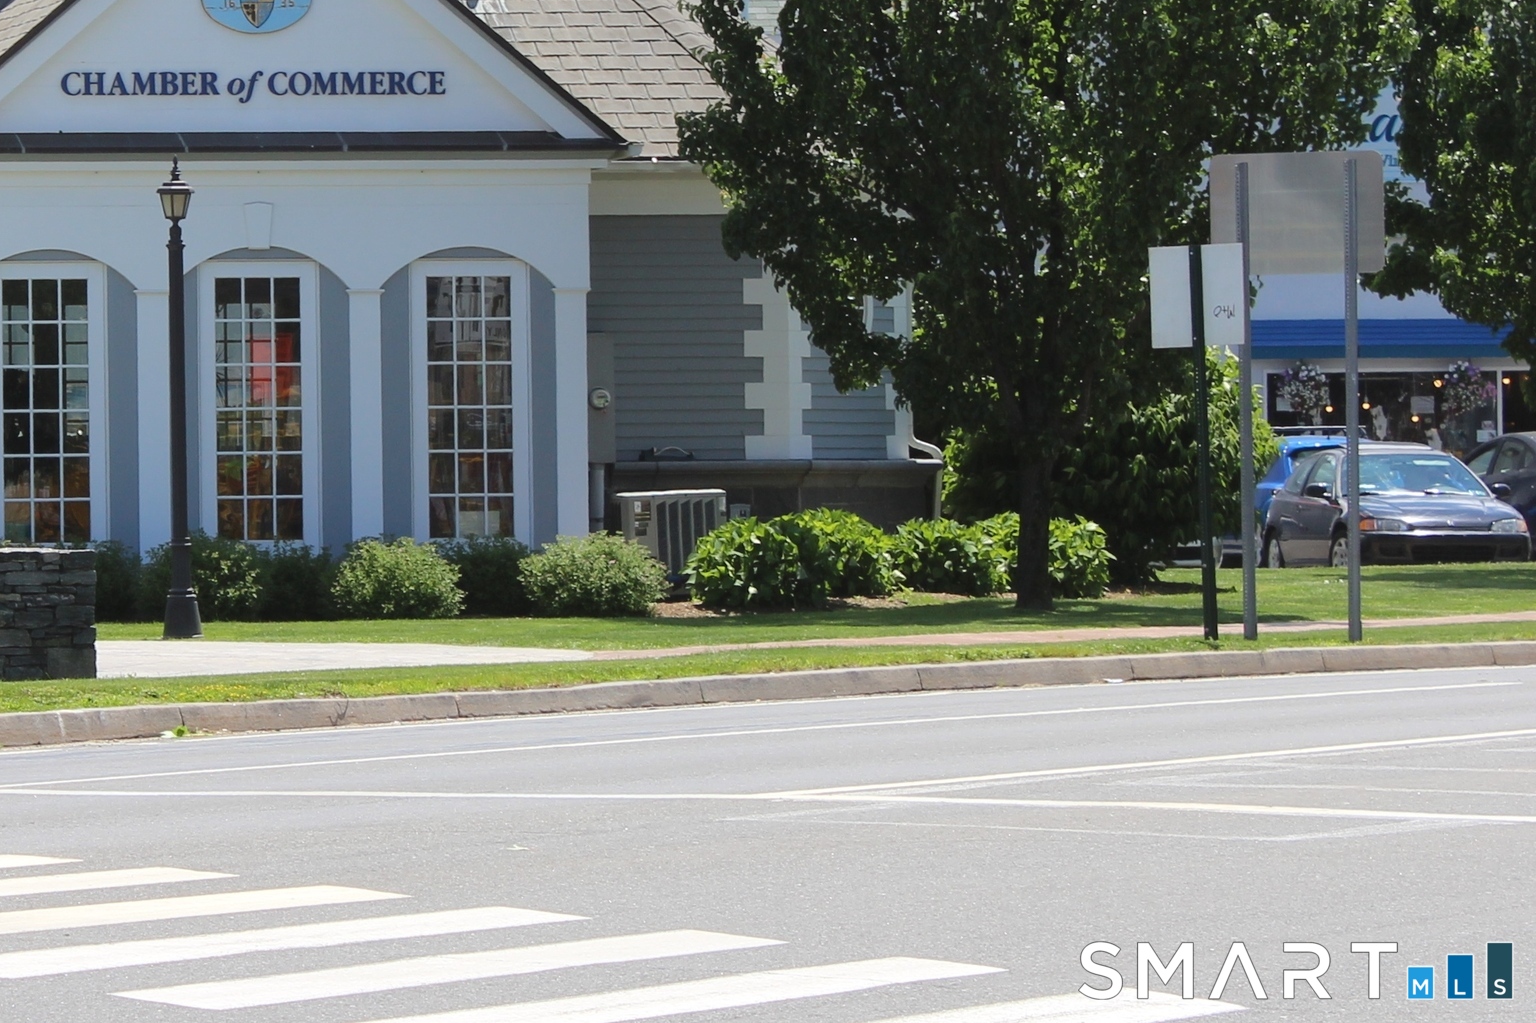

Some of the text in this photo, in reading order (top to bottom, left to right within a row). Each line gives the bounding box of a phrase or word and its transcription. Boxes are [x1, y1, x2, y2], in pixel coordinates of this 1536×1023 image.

[61, 70, 446, 104] CHAMBER of COMMERCE
